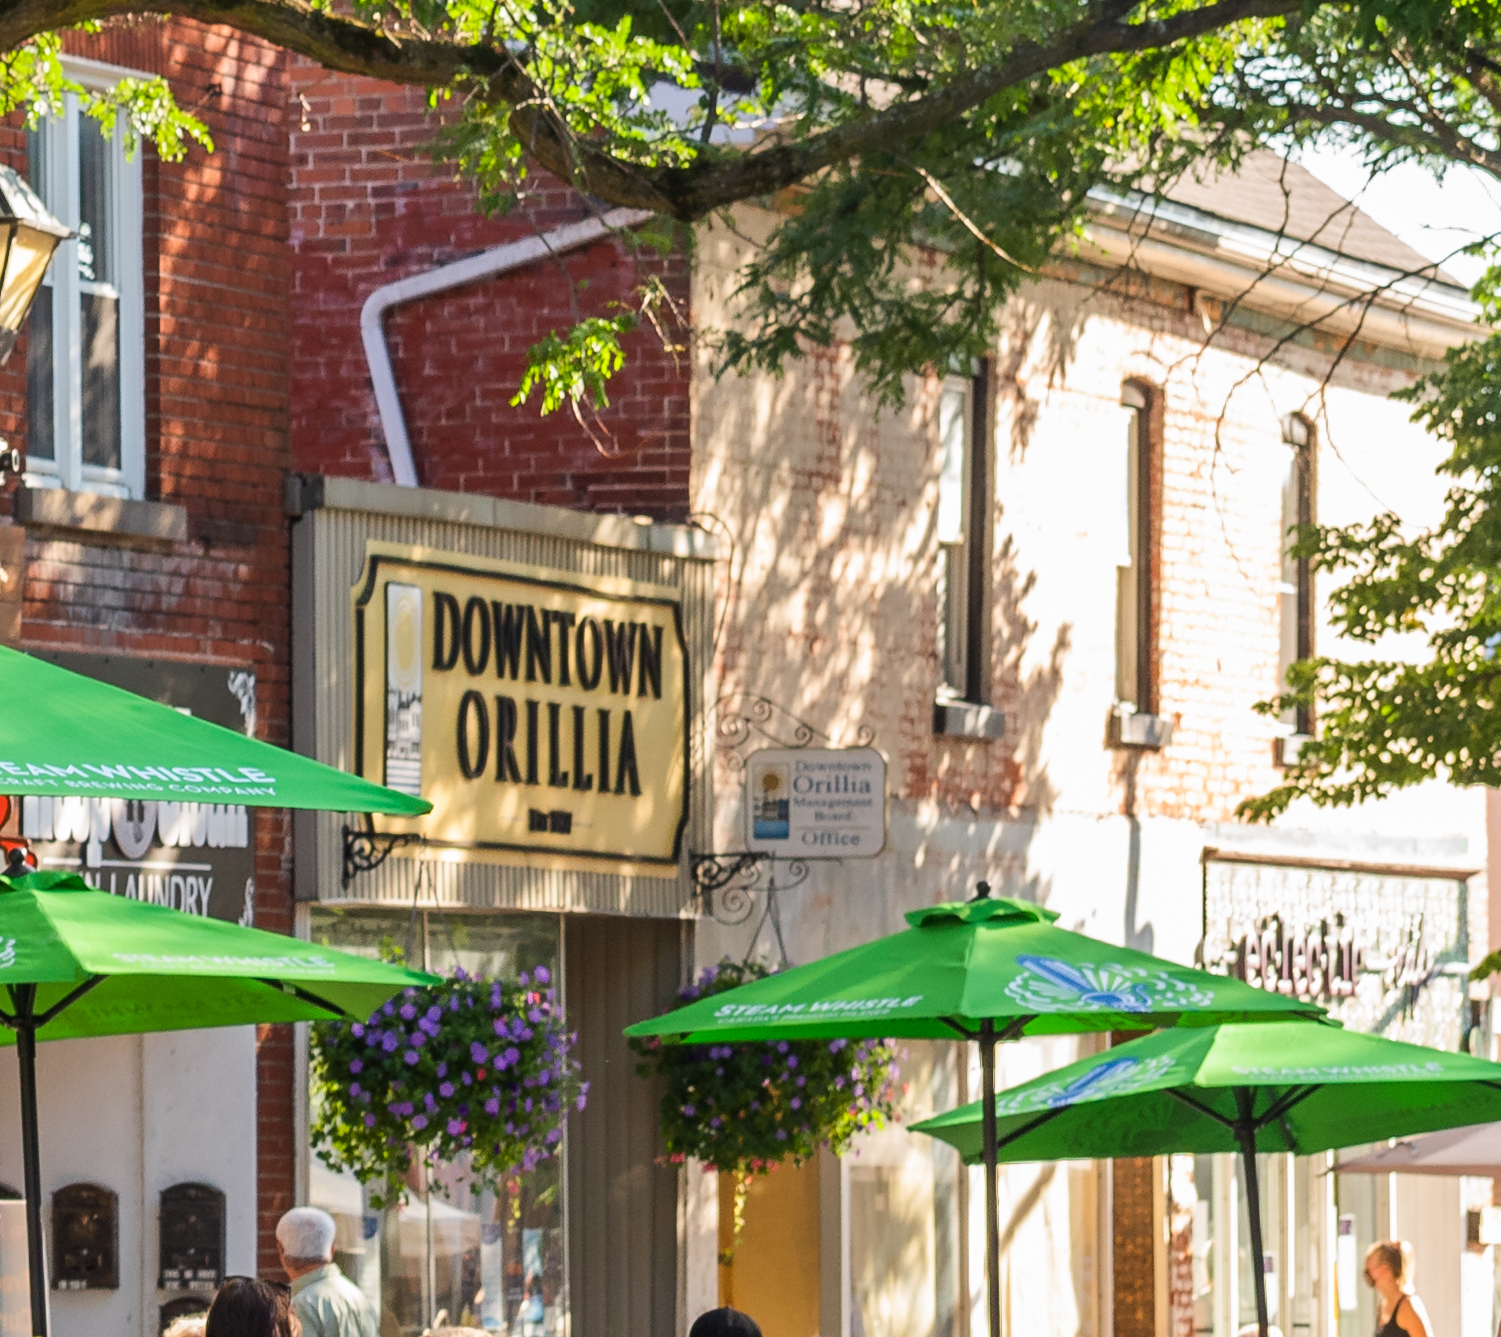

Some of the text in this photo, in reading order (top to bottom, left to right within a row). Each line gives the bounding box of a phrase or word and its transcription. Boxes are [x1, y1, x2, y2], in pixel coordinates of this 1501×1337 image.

[431, 590, 665, 700] DOWNTOWN
[456, 689, 642, 797] ORILLIA
[84, 763, 276, 784] WHISTLE
[794, 760, 873, 772] Downtown
[66, 779, 164, 793] BREWING
[169, 783, 276, 797] COMPANY
[792, 774, 872, 794] Orillia
[800, 832, 861, 846] Office
[713, 1003, 806, 1017] STEAM
[809, 995, 923, 1012] WHISTLE
